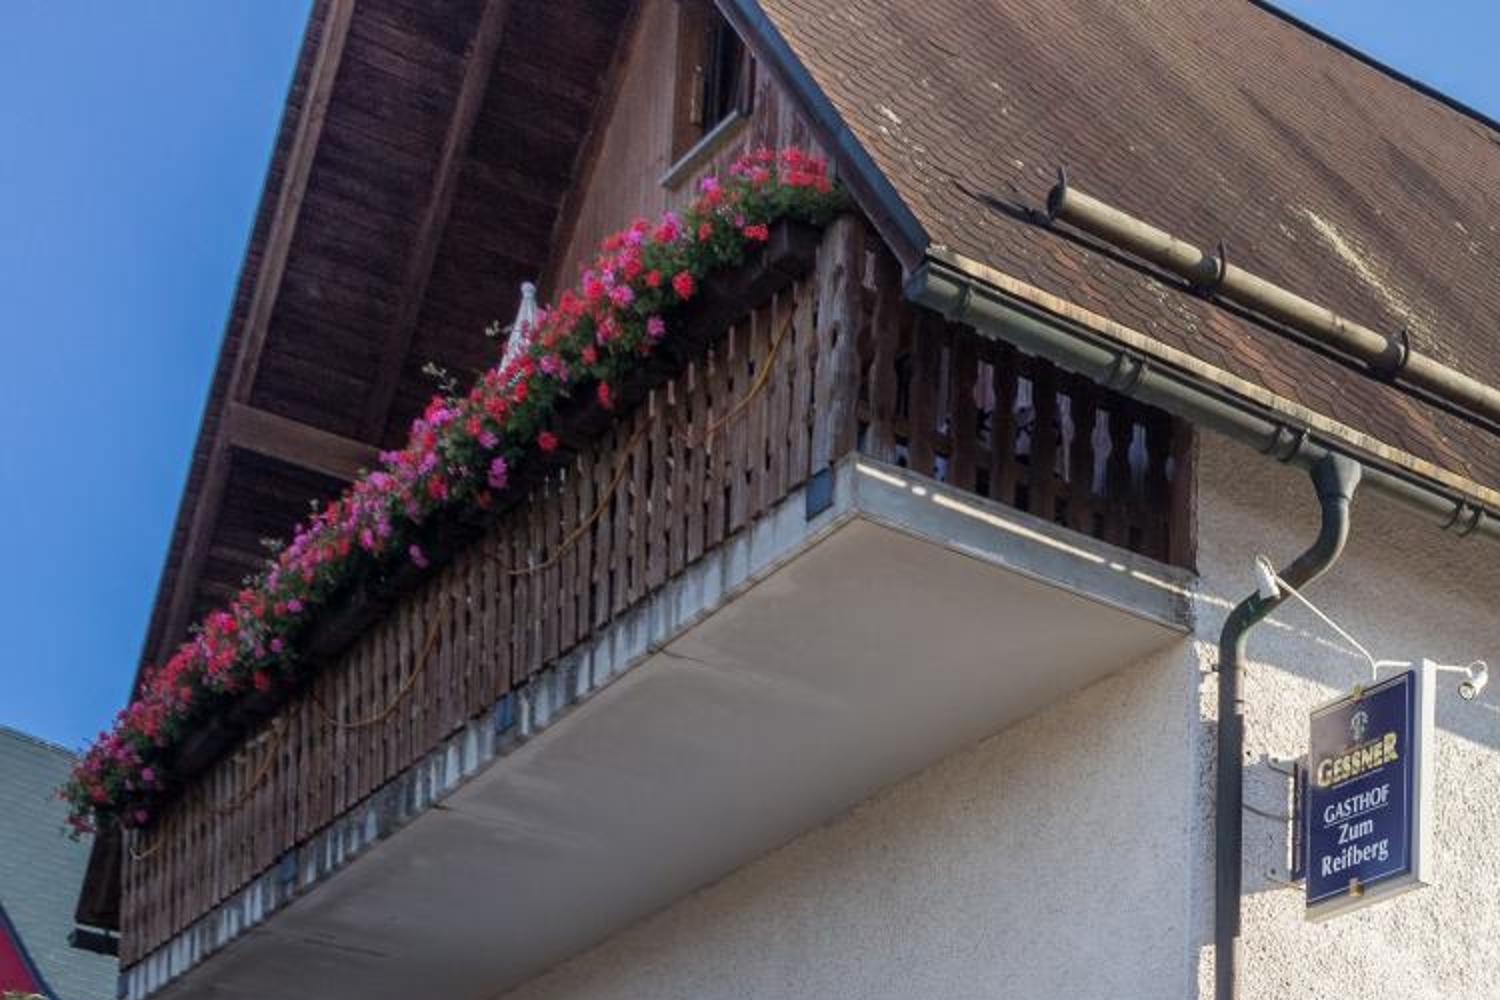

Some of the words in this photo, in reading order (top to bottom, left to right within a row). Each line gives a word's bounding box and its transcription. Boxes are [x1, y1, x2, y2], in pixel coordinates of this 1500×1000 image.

[1318, 732, 1399, 787] GESSNER
[1323, 783, 1389, 824] GASTHOF
[1338, 818, 1373, 845] Zum
[1322, 839, 1389, 877] Reifberg
